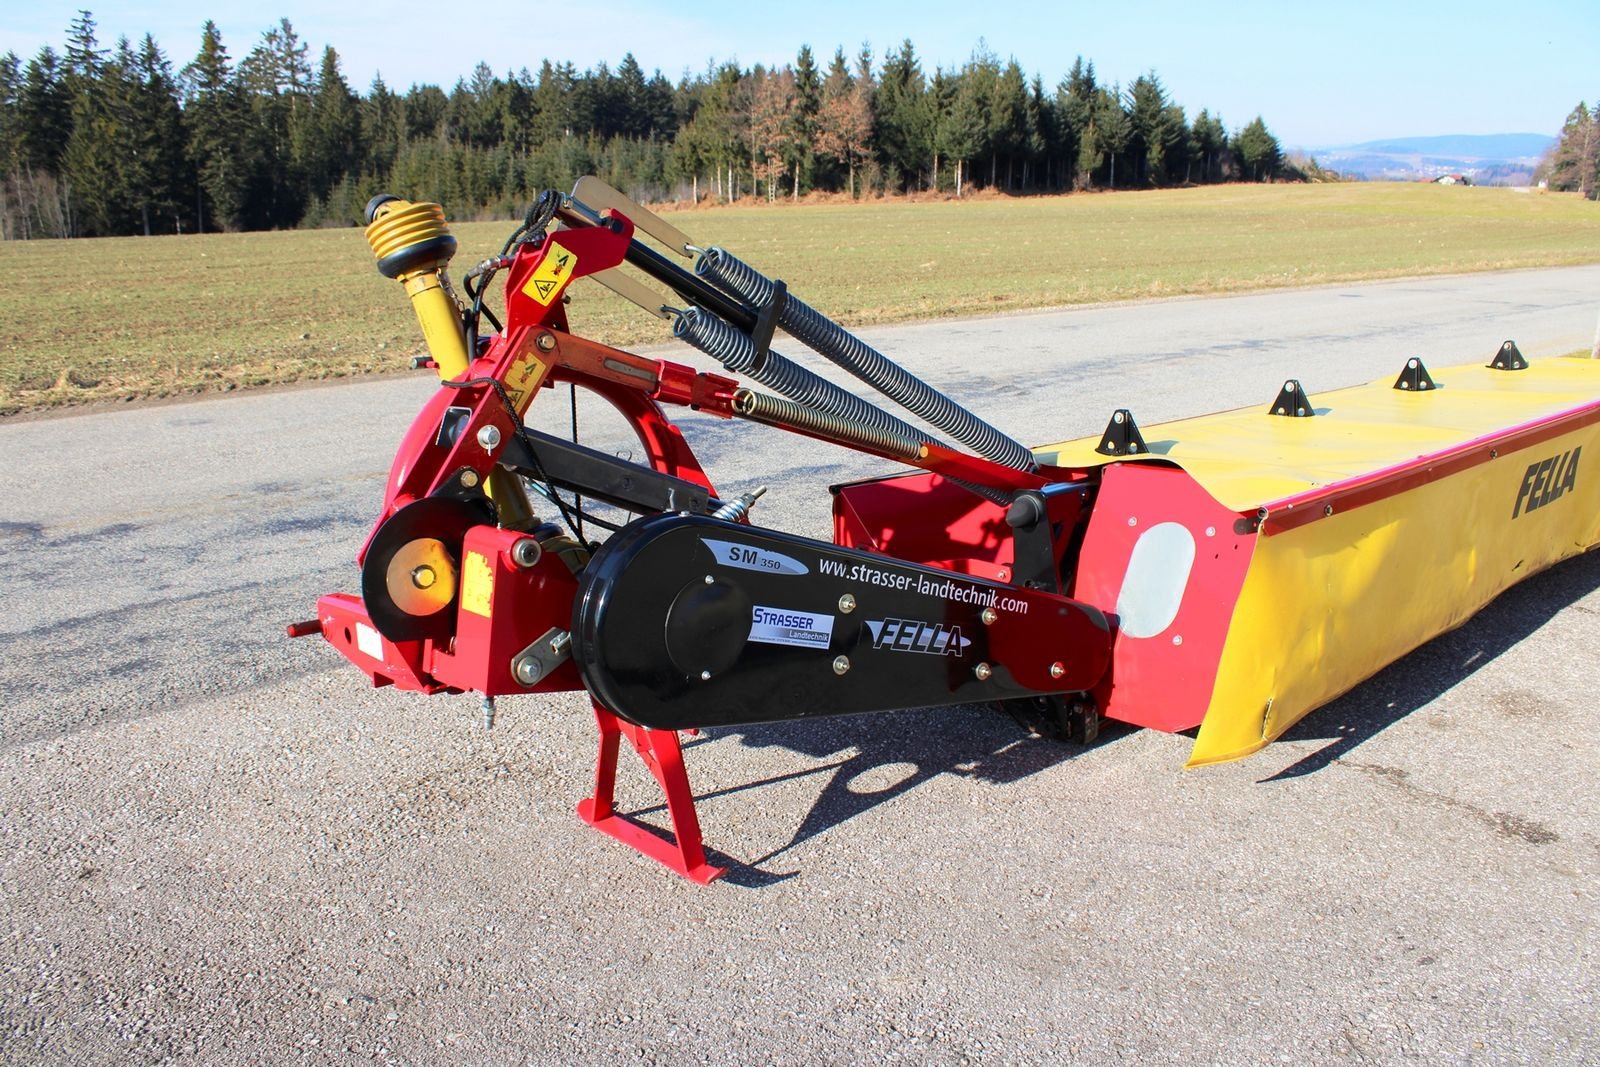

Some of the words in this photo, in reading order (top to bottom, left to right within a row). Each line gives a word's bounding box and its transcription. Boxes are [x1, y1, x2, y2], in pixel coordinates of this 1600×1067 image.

[1512, 445, 1582, 520] FELLA
[729, 547, 757, 565] SM
[760, 558, 781, 570] 350
[789, 630, 828, 642] Landtechnik
[873, 617, 962, 657] FELLA
